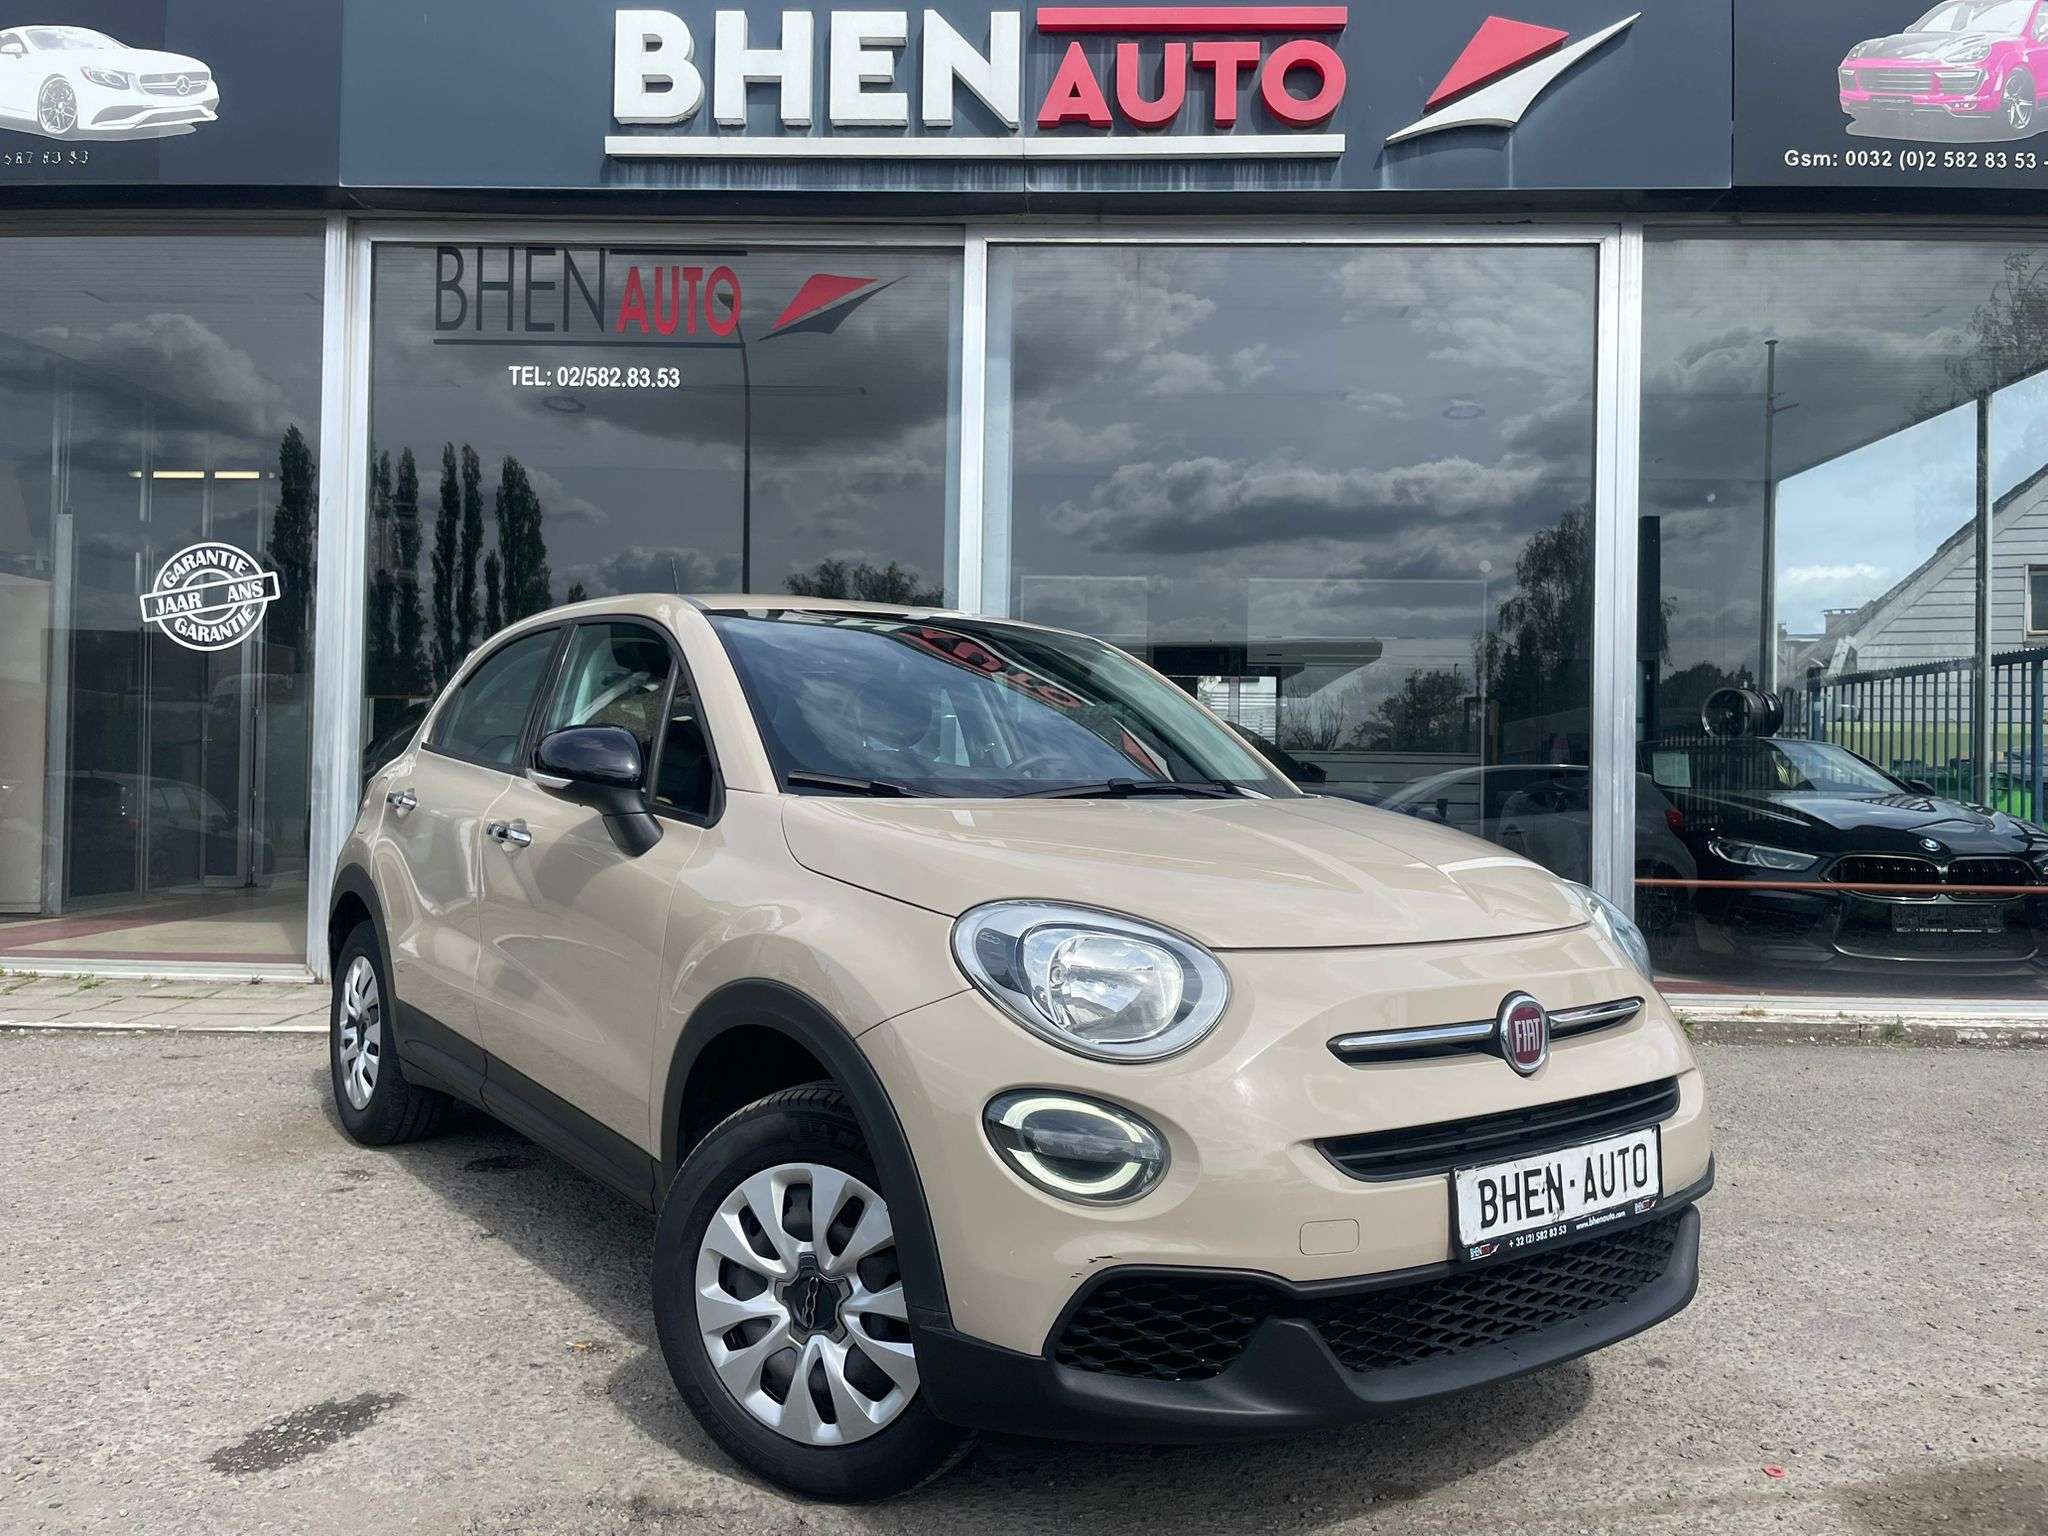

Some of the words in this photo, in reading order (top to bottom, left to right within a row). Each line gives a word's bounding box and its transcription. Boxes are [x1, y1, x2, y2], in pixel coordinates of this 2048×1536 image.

[614, 9, 1021, 128] BHEN
[1037, 39, 1347, 128] AUTO
[1784, 150, 1838, 167] Gsm:
[1845, 150, 1893, 167] 0032
[1899, 150, 1937, 171] (0)2
[1944, 151, 1978, 168] 582
[1985, 152, 2007, 168] 83
[2014, 152, 2037, 169] 53
[435, 247, 606, 332] BHEN
[616, 265, 742, 336] AUTO
[508, 365, 552, 387] TEL:
[557, 366, 681, 388] 02/582.83.53
[162, 549, 249, 588] GARANTIE
[155, 592, 202, 615] JAAR
[228, 580, 265, 603] ANS
[174, 603, 256, 642] GARANTIE
[1514, 1018, 1540, 1053] FIAT
[1478, 1163, 1565, 1229] BHEN
[1584, 1143, 1648, 1203] AUTO
[1516, 1236, 1525, 1247] 32
[1535, 1228, 1548, 1242] 582
[1549, 1226, 1558, 1238] 83
[1558, 1224, 1567, 1235] 53
